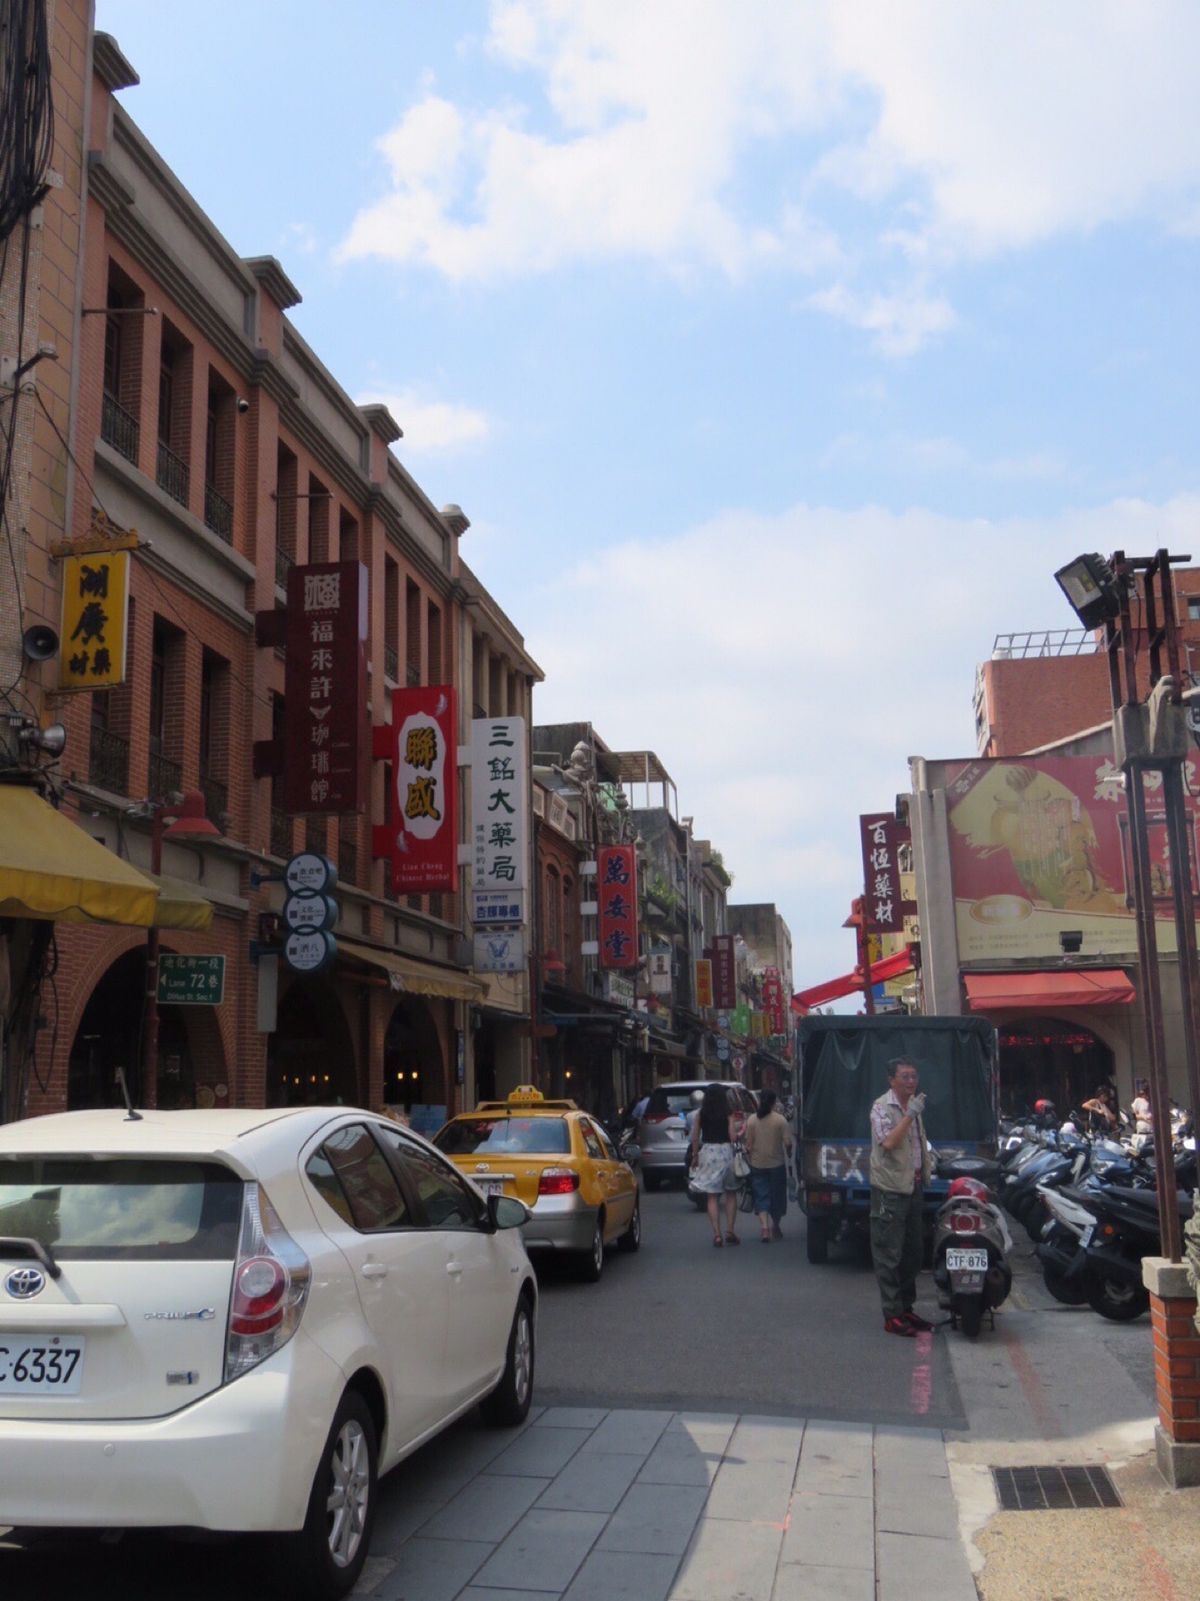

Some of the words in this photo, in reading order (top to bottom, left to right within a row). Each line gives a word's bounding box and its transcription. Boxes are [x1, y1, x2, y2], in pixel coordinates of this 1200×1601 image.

[488, 725, 517, 882] 三銘大藥局
[603, 856, 631, 960] 萬安堂
[190, 974, 206, 988] 72
[208, 974, 218, 988] 巷
